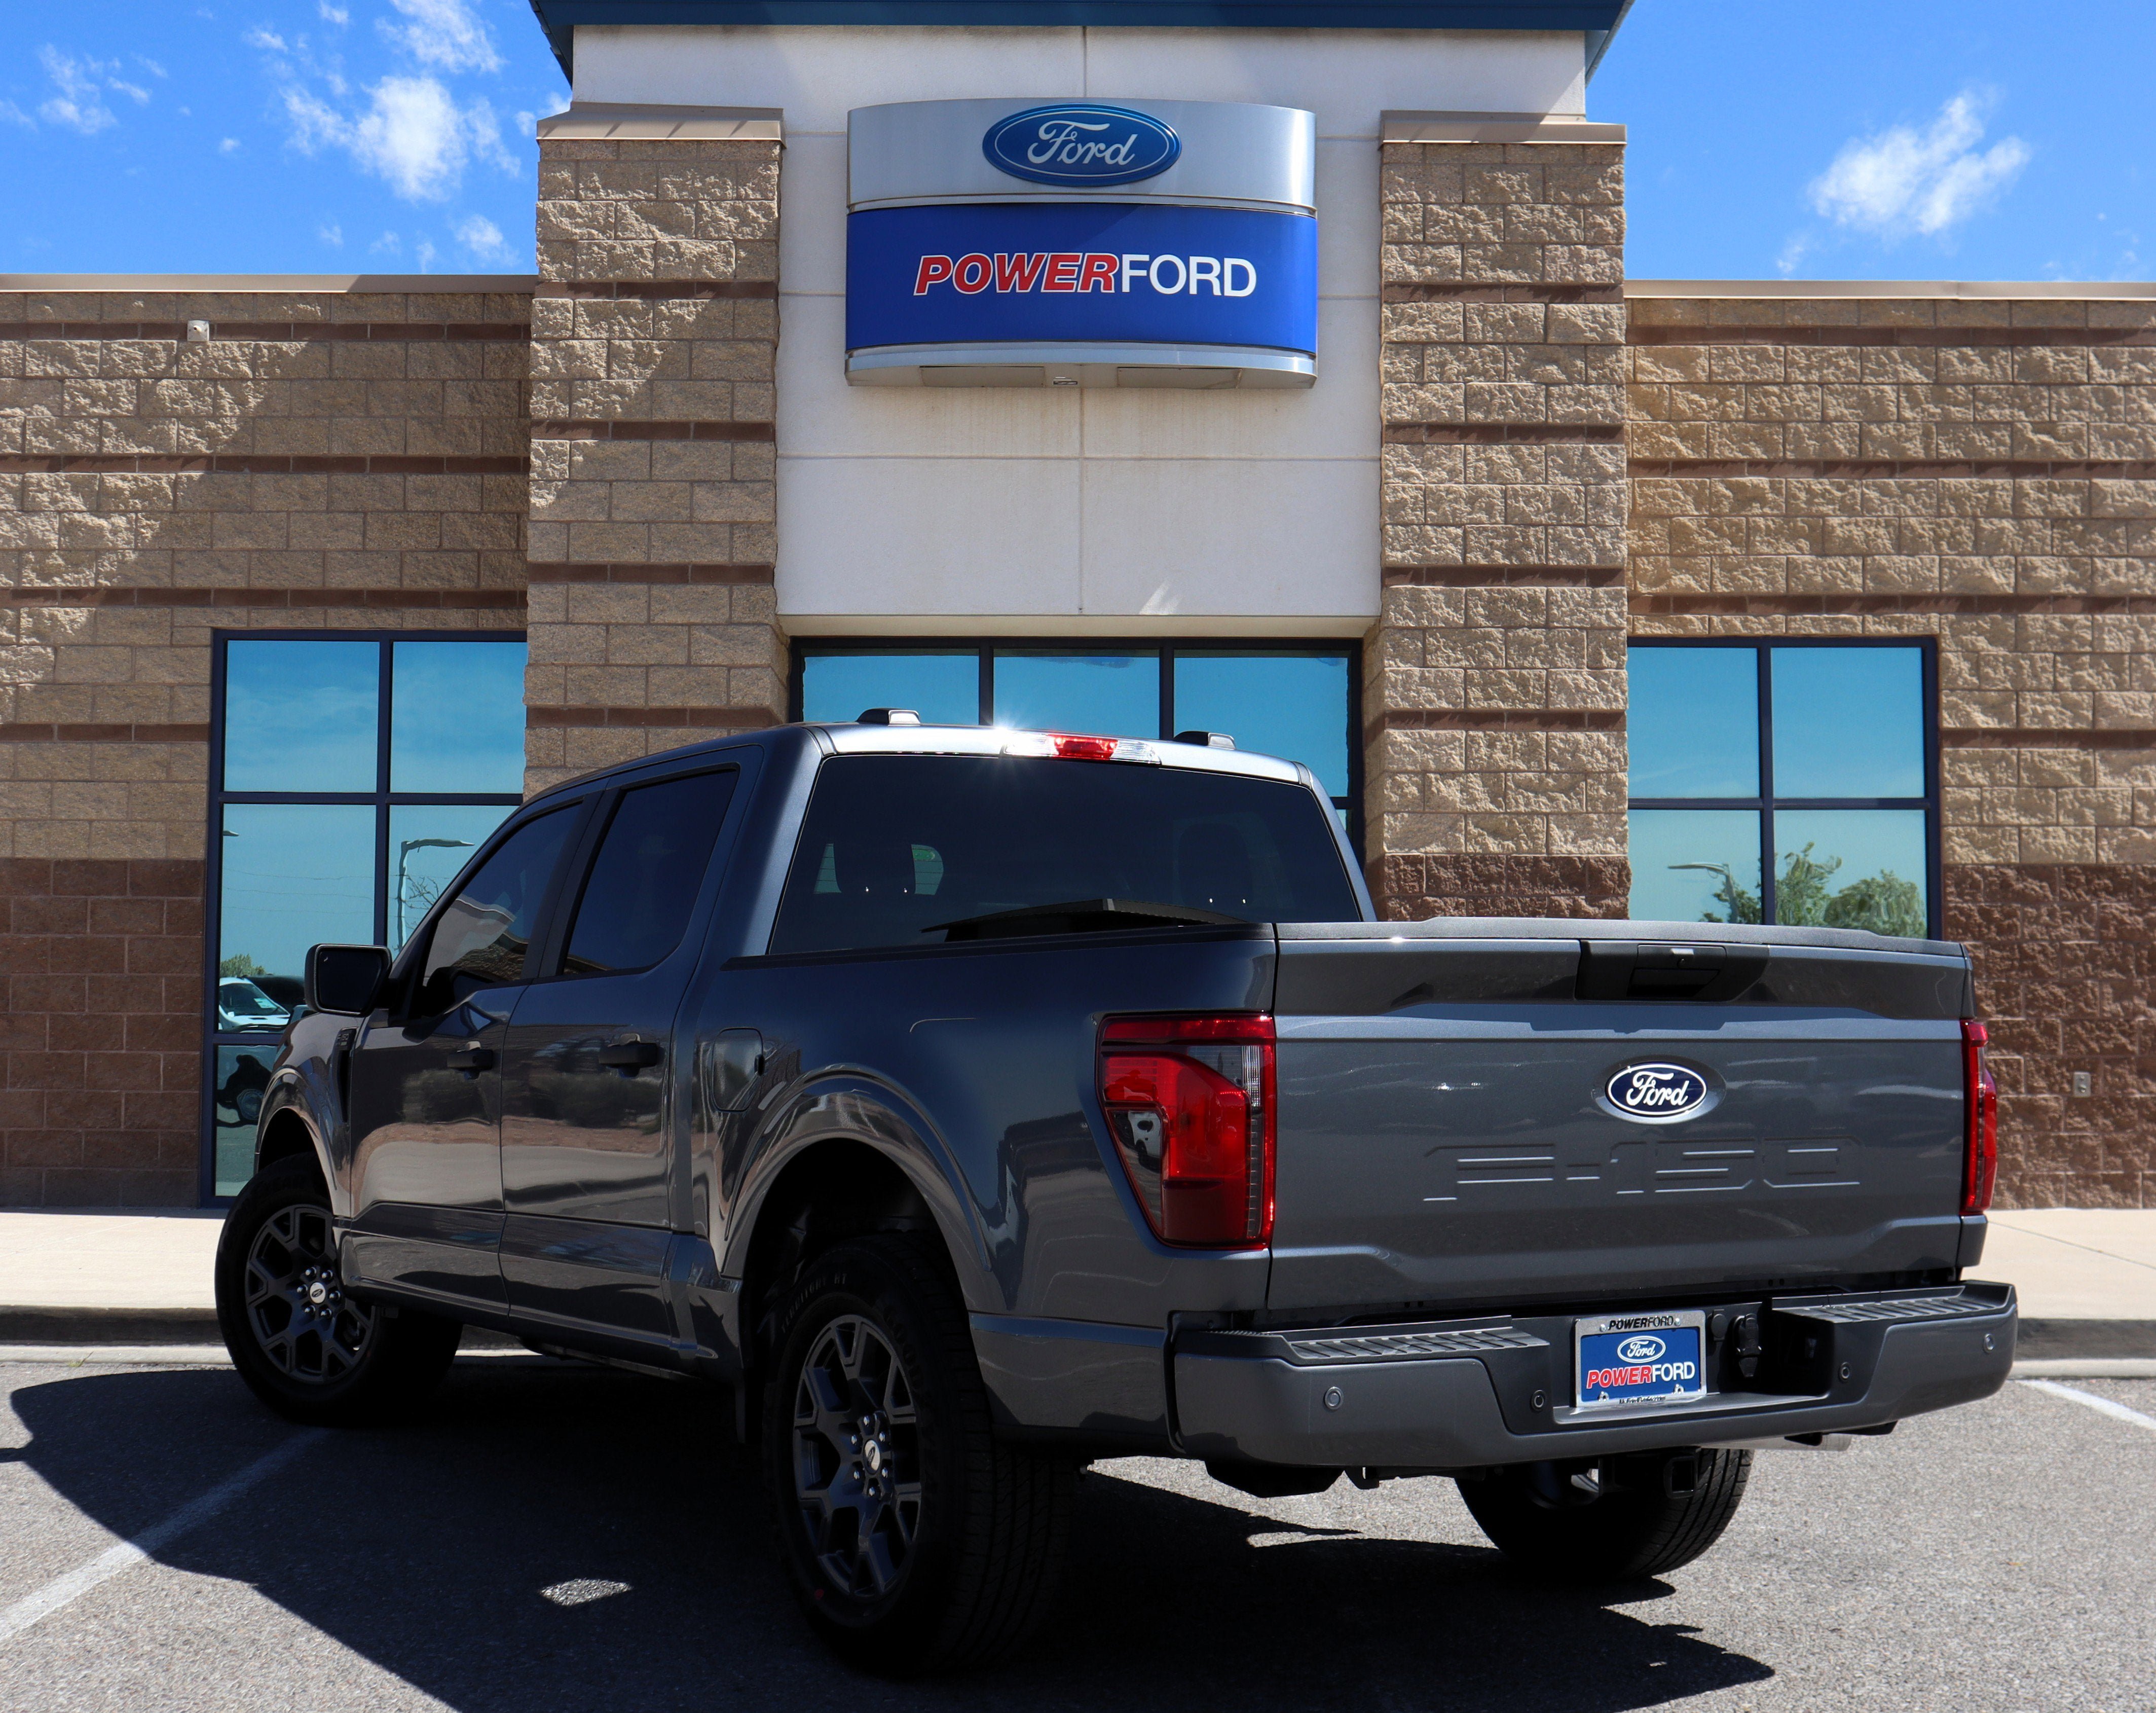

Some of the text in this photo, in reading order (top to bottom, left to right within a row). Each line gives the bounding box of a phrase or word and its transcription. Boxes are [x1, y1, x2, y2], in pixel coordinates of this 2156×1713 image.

[1027, 120, 1136, 166] Ford
[913, 252, 1257, 297] POWERFORD
[1626, 1071, 1690, 1106] Ford
[1608, 1316, 1674, 1331] POWERFORD
[1627, 1340, 1656, 1357] Ford
[1586, 1362, 1695, 1389] POWERFORD
